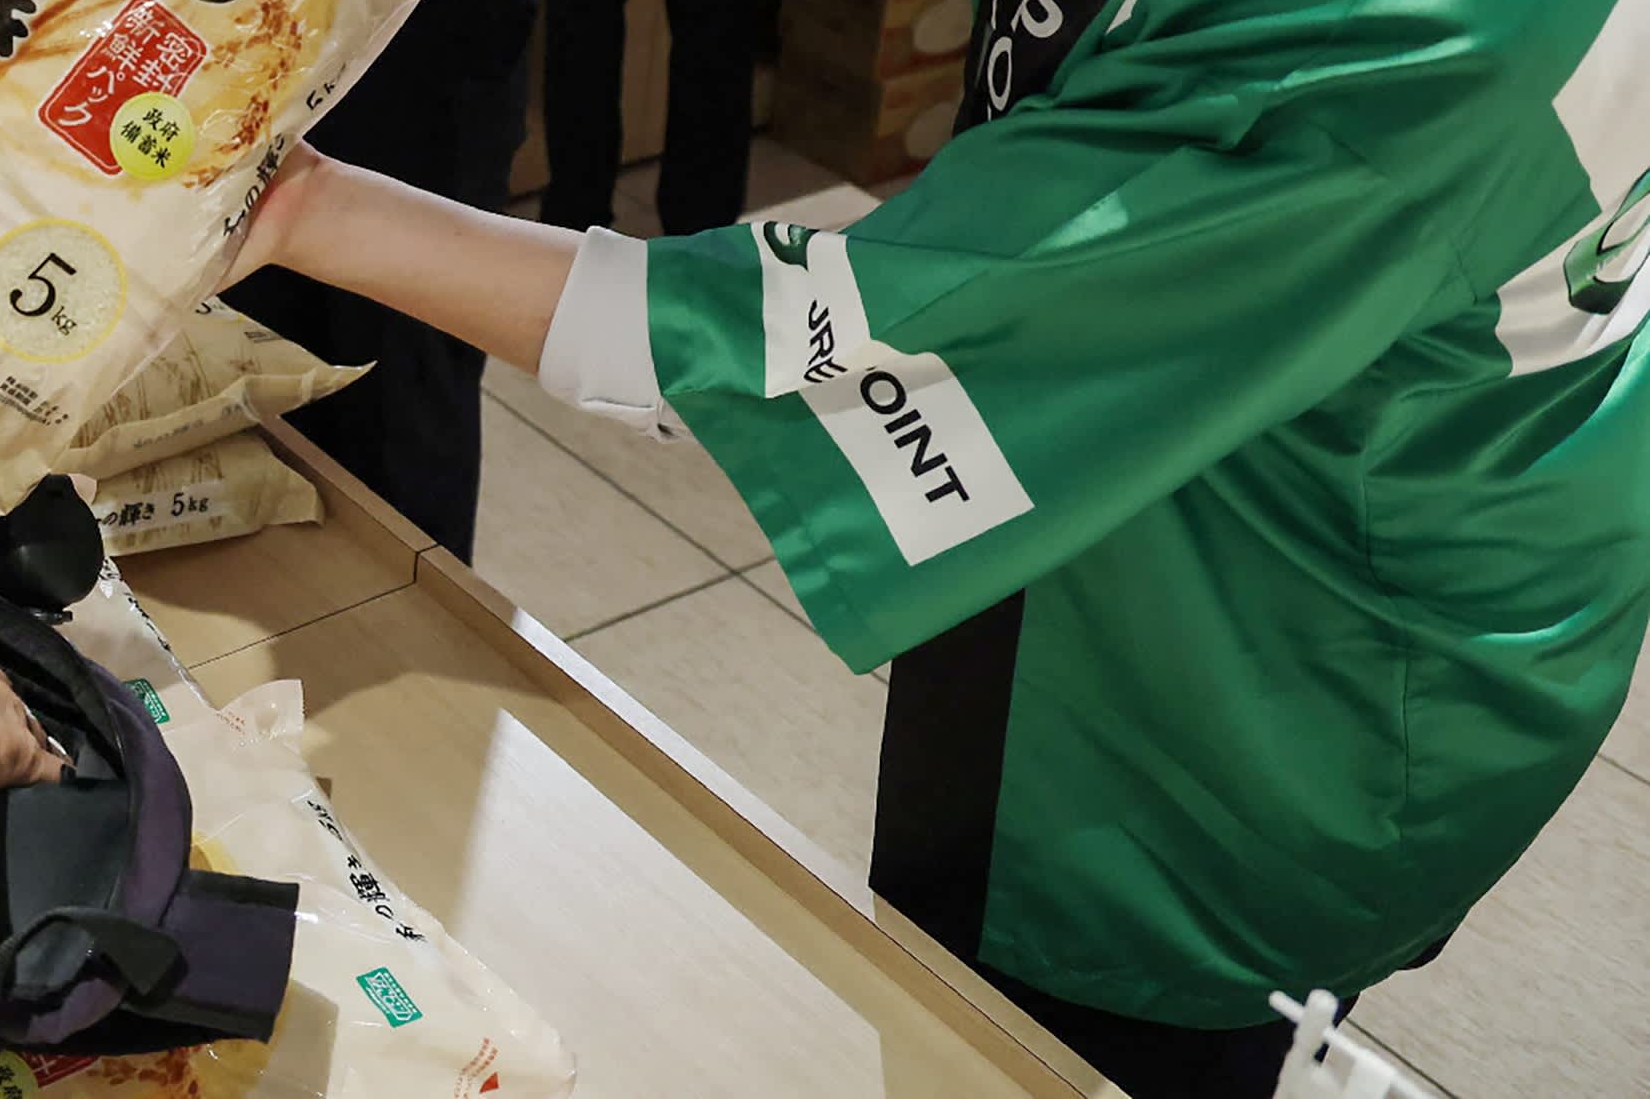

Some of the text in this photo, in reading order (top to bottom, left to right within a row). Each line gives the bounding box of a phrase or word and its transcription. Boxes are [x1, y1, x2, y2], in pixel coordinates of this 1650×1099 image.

[57, 6, 166, 127] 新鮮パック
[119, 119, 173, 169] 備蓄米
[143, 108, 181, 143] 政府
[803, 299, 848, 384] JRE
[859, 366, 971, 504] OINT
[94, 491, 210, 527] の輝き 5kg
